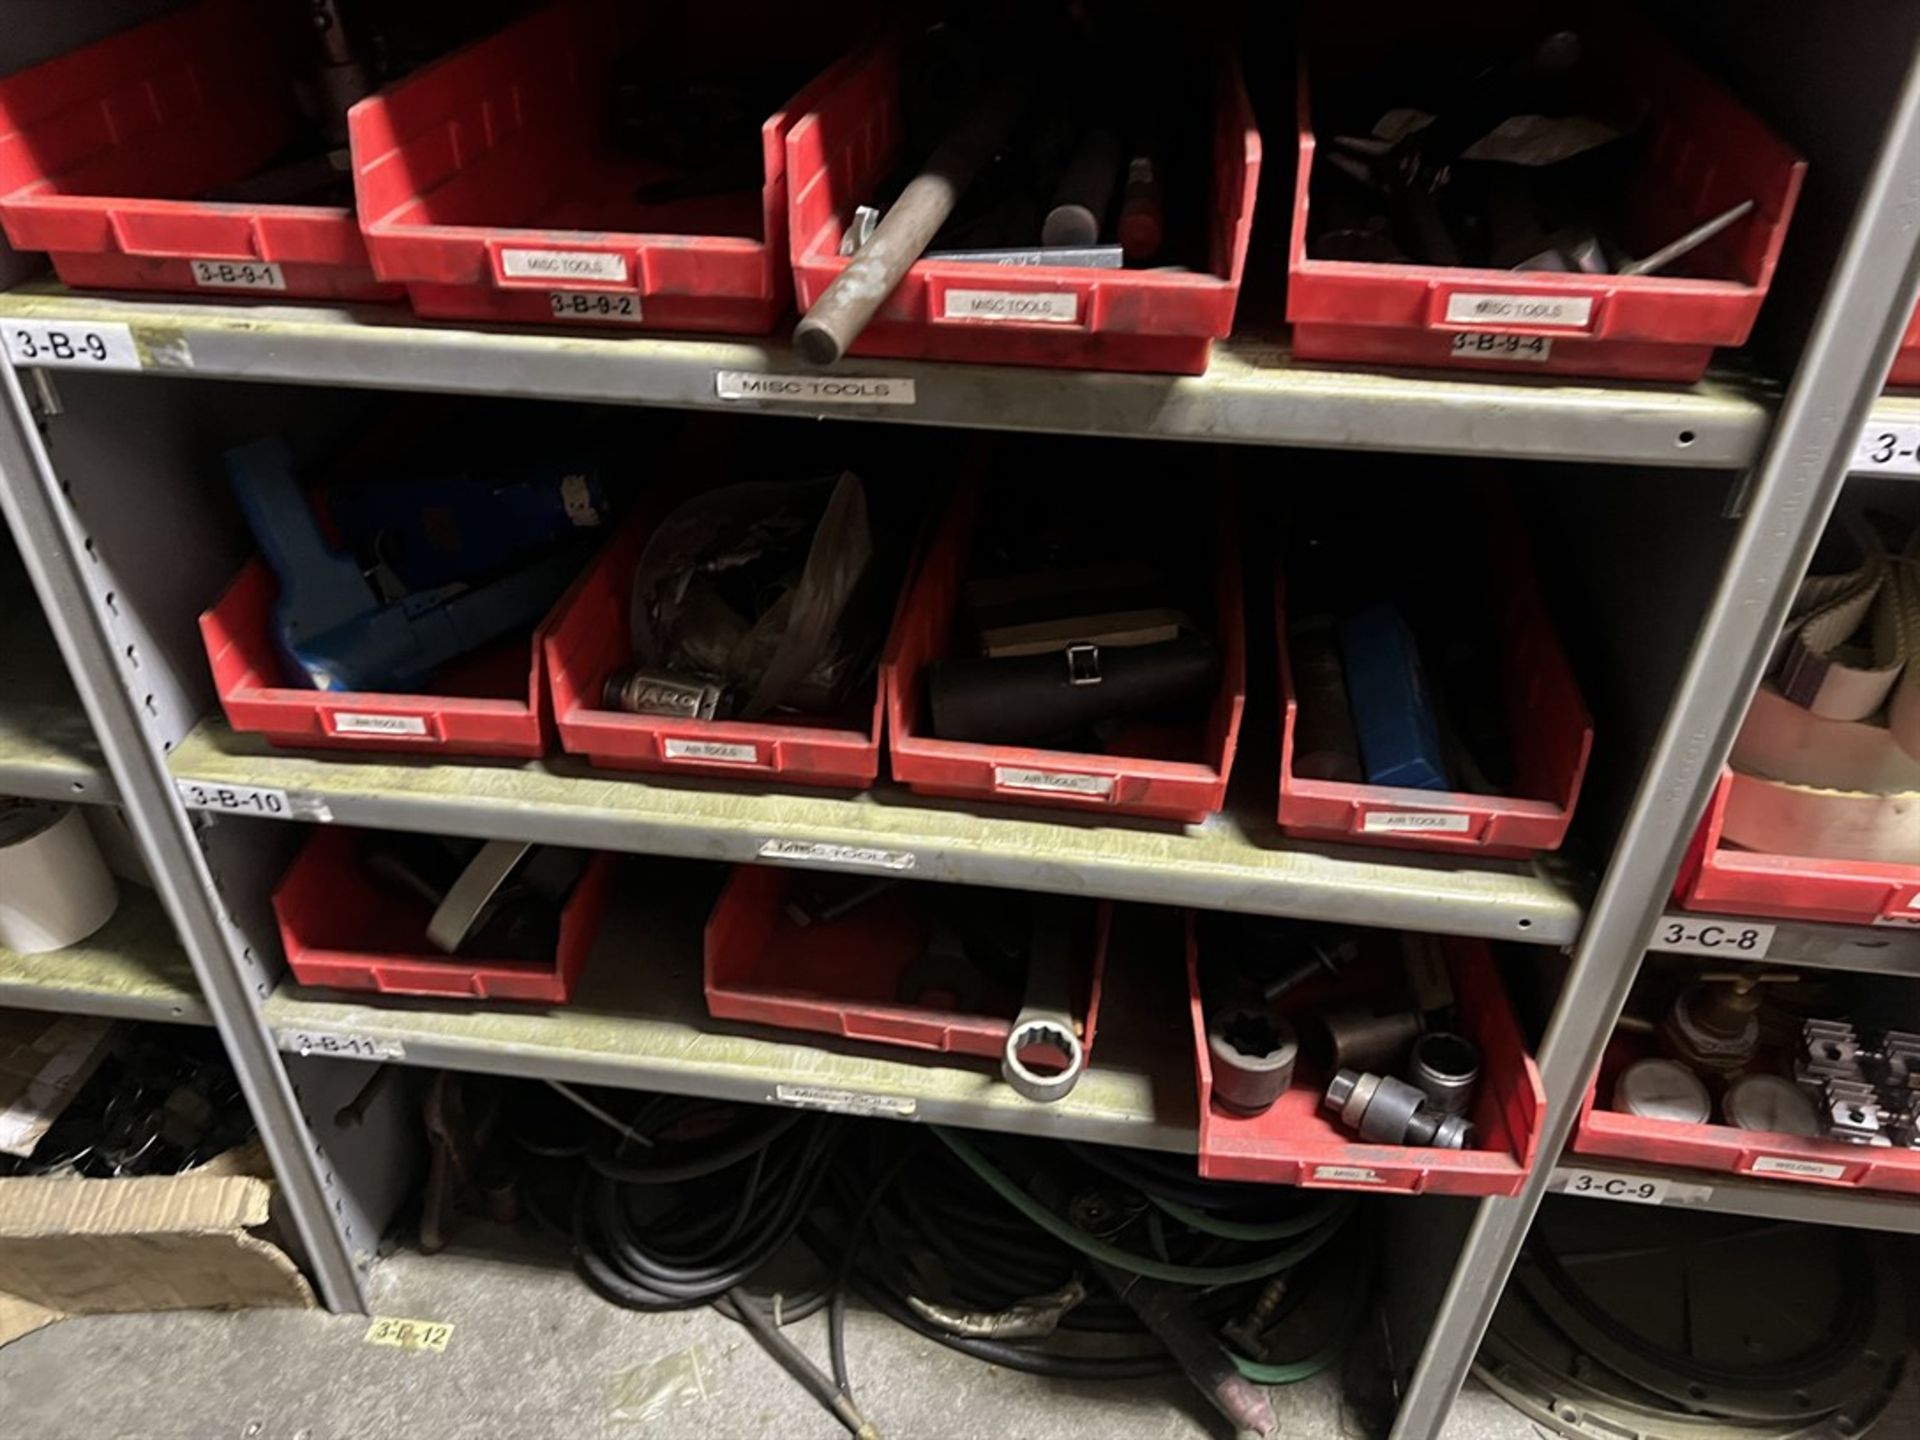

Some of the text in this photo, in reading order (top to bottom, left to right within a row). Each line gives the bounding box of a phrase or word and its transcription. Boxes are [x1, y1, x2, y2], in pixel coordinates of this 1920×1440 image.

[198, 264, 275, 285] 3-B-9-1
[527, 258, 603, 274] MISC TOOLS
[552, 295, 632, 315] 3-B-9-2
[971, 299, 1053, 314] MISC TOOLS
[1515, 303, 1563, 318] TOOLS
[17, 330, 107, 361] 3-B-9
[1453, 333, 1545, 354] 3-B-9-4
[742, 380, 890, 397] MISC TOOLS
[1871, 433, 1920, 464] 3-
[191, 786, 282, 813] 3-B-10
[1664, 923, 1760, 950] 3-C-8
[296, 1034, 375, 1056] 3-B-11
[1576, 1175, 1656, 1199] 3-C-9
